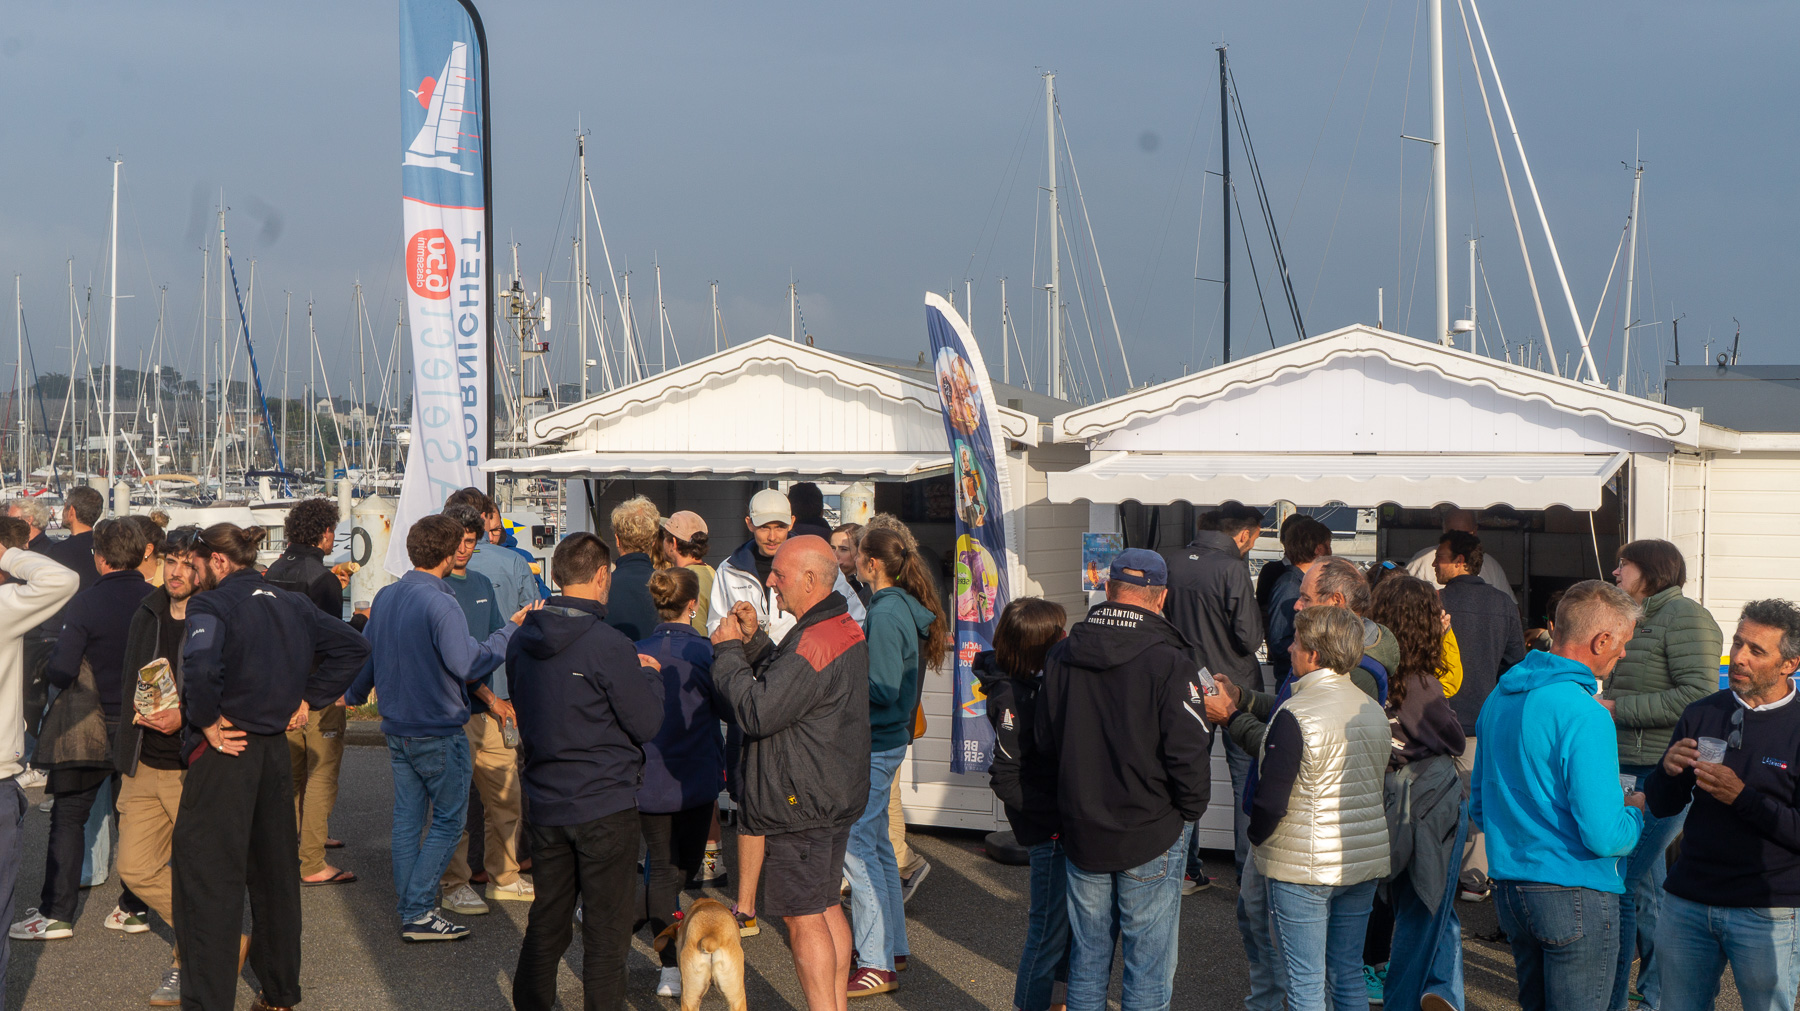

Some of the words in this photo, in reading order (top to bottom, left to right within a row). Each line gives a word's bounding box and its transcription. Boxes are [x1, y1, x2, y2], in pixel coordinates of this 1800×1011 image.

[1088, 617, 1105, 625] COURSE
[1107, 618, 1115, 626] AU
[1116, 619, 1137, 628] LARGE
[431, 920, 446, 931] N
